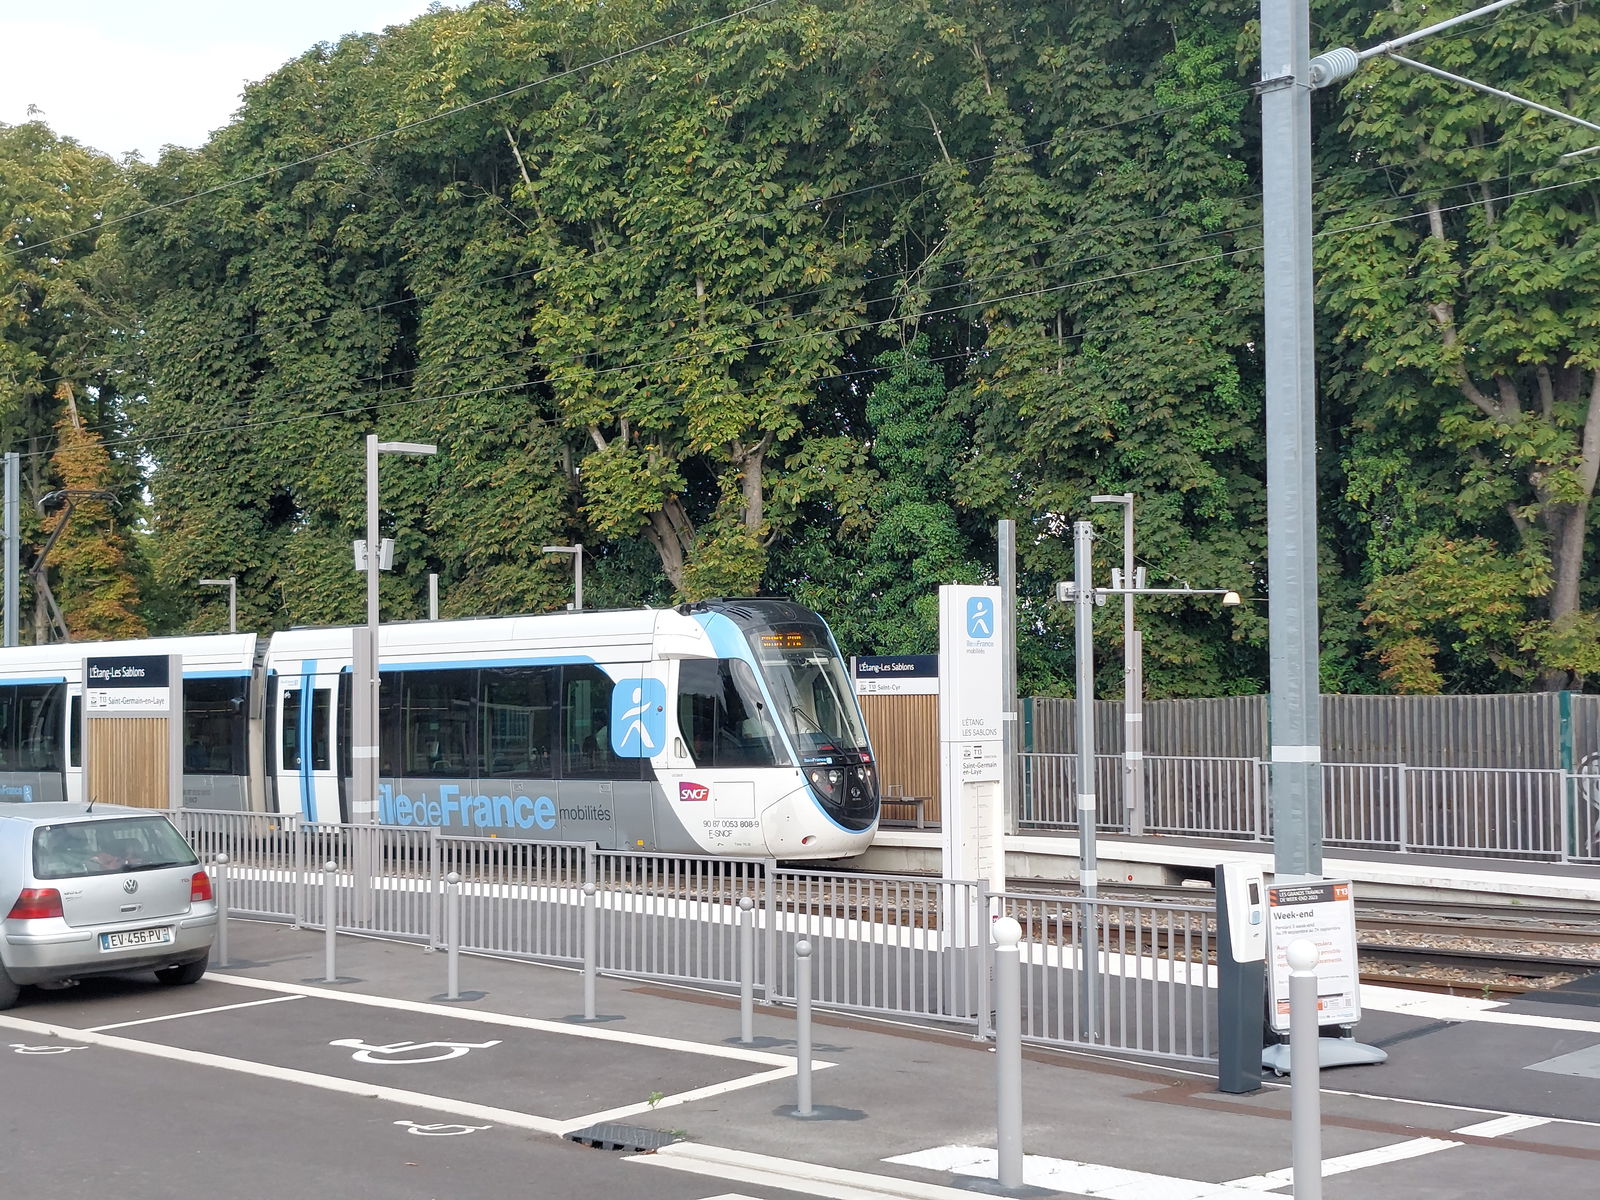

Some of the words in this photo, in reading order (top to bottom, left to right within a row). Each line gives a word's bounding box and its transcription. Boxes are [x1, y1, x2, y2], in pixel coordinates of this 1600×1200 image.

[89, 664, 121, 681] L'Étang-Les
[122, 665, 146, 678] Sablons
[858, 661, 891, 674] L'Étang-Les
[892, 662, 915, 672] Sablons
[108, 696, 165, 706] Saint-Germain-en-Laye
[962, 728, 971, 737] LES
[973, 728, 998, 737] SABLONS
[680, 788, 708, 800] SNCF
[559, 804, 611, 822] mobilités
[703, 820, 712, 828] 90
[721, 820, 739, 828] 0053
[1335, 888, 1348, 897] T13
[1273, 909, 1314, 920] Week-end
